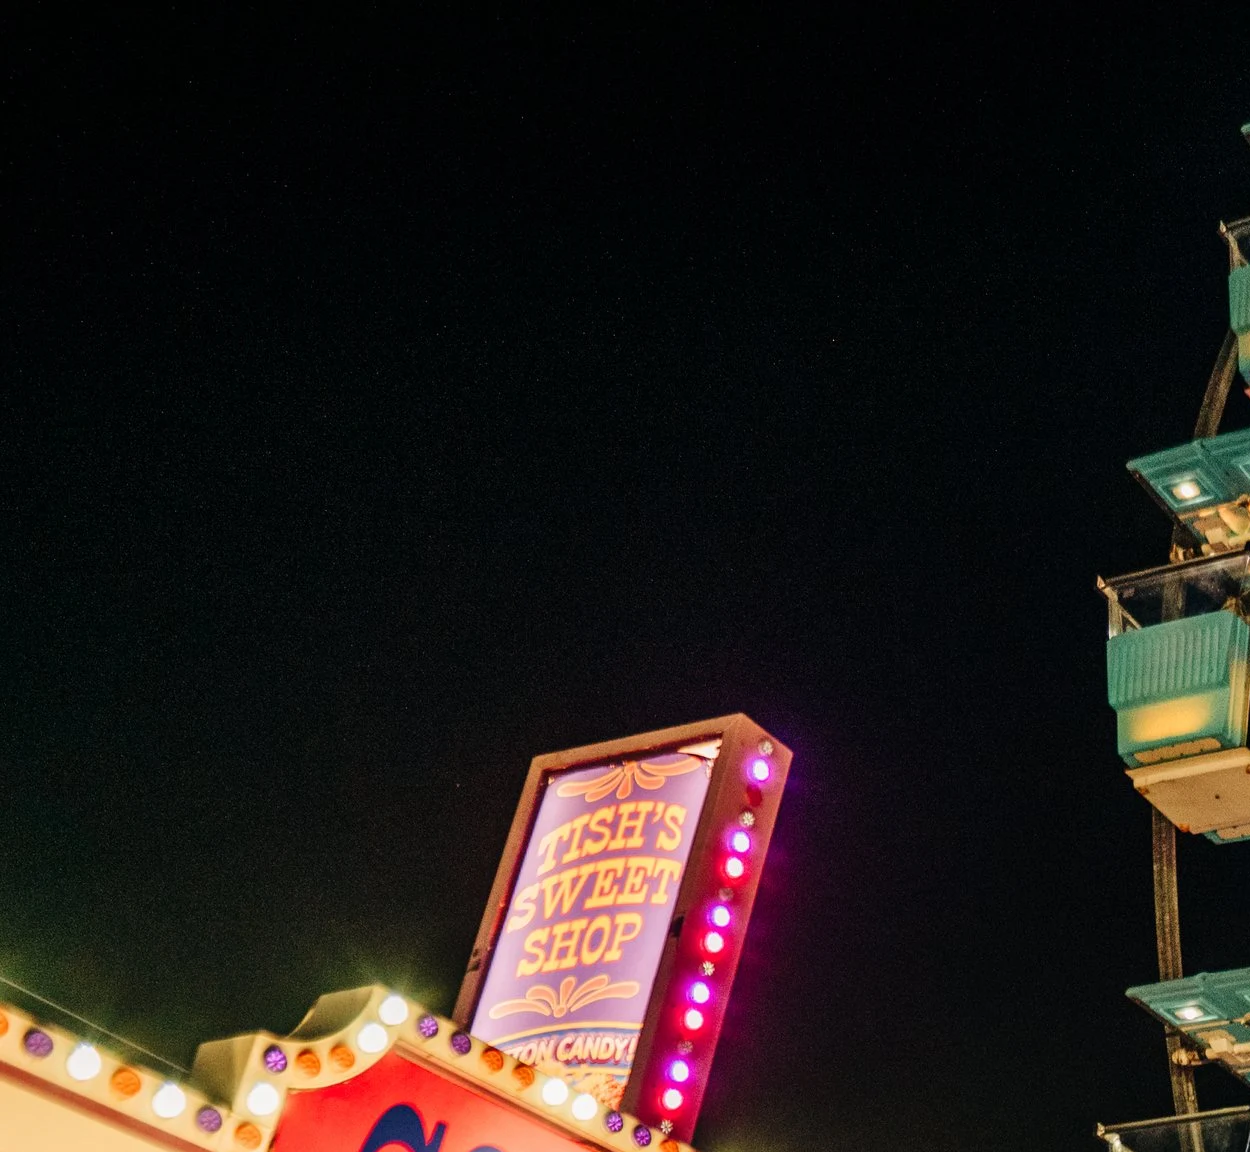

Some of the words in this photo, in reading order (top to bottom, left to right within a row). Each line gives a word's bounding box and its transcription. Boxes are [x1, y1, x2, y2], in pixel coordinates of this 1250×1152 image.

[536, 801, 688, 877] TISH'S
[506, 857, 682, 935] SWEET
[516, 911, 643, 978] SHOP
